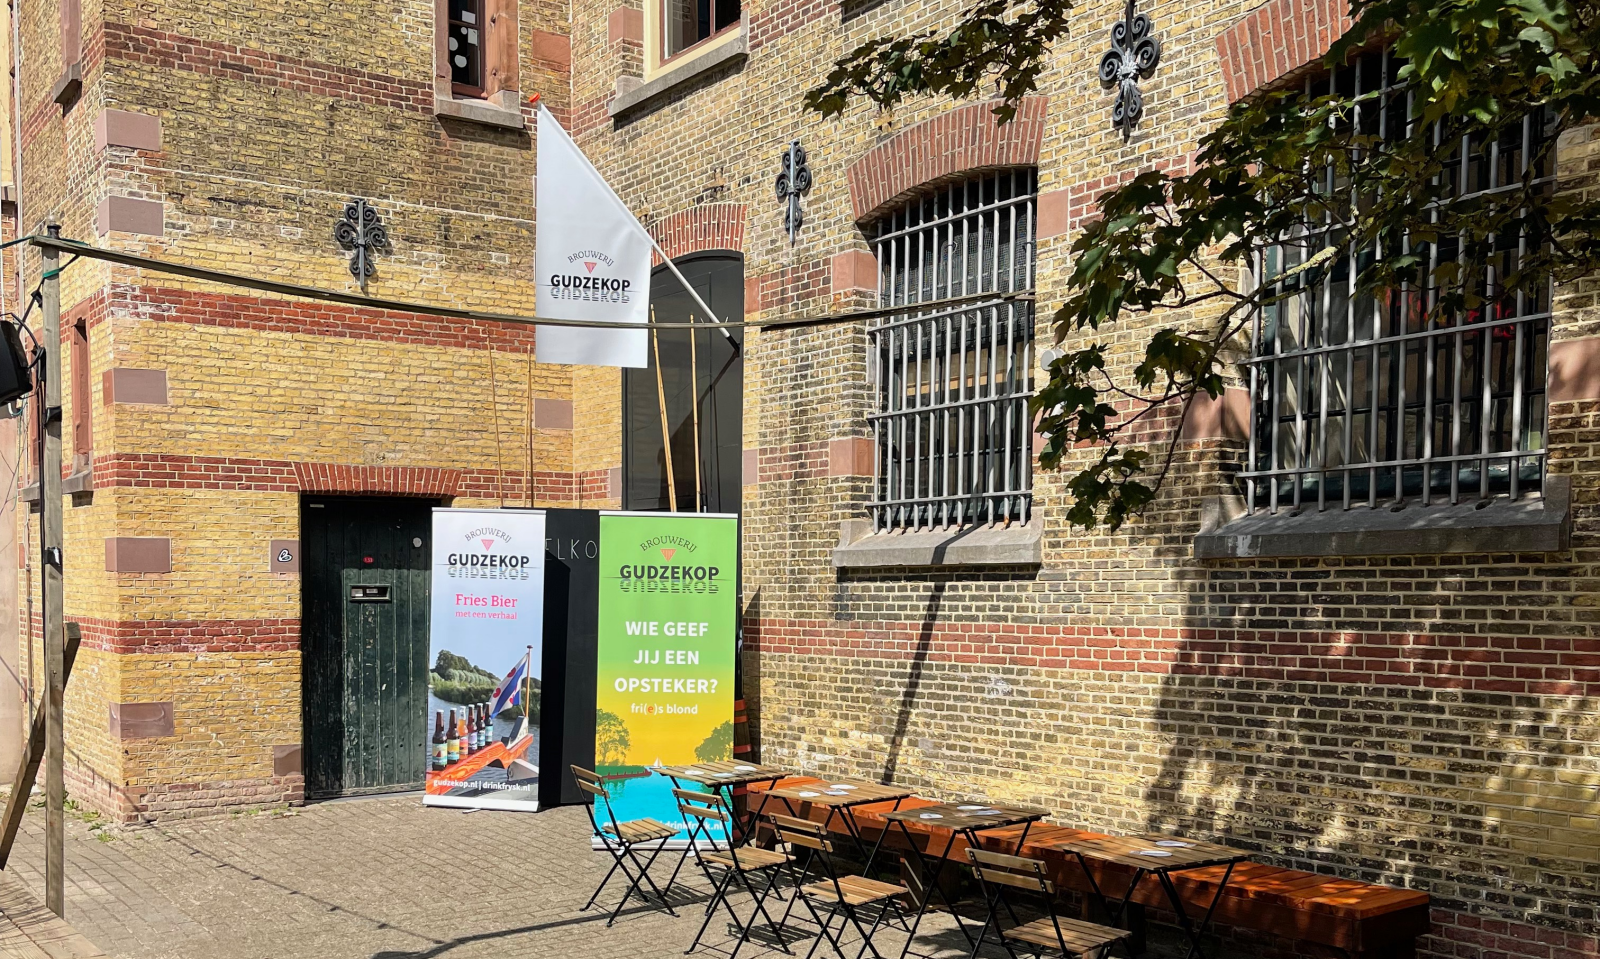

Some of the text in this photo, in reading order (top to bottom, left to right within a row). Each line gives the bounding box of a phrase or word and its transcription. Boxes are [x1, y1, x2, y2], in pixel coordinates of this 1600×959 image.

[567, 250, 614, 267] BROUWERIJ
[550, 274, 631, 292] GUDZEKOP
[464, 527, 512, 544] BROUWERIJ
[639, 535, 697, 553] BROUWERIJ
[448, 553, 530, 568] GUDZEKOP
[620, 565, 720, 581] GUDZEKOP
[455, 593, 518, 608] Fries Bier
[472, 611, 487, 619] een
[488, 611, 518, 620] verhaal
[625, 621, 709, 637] WIE GEEF
[633, 649, 699, 665] JIJ EEN
[614, 677, 719, 694] OPSTEKER?
[630, 703, 698, 716] fri(e)s blond
[433, 780, 477, 789] gudzekop.nl
[482, 781, 531, 792] drinkfrysk.nl
